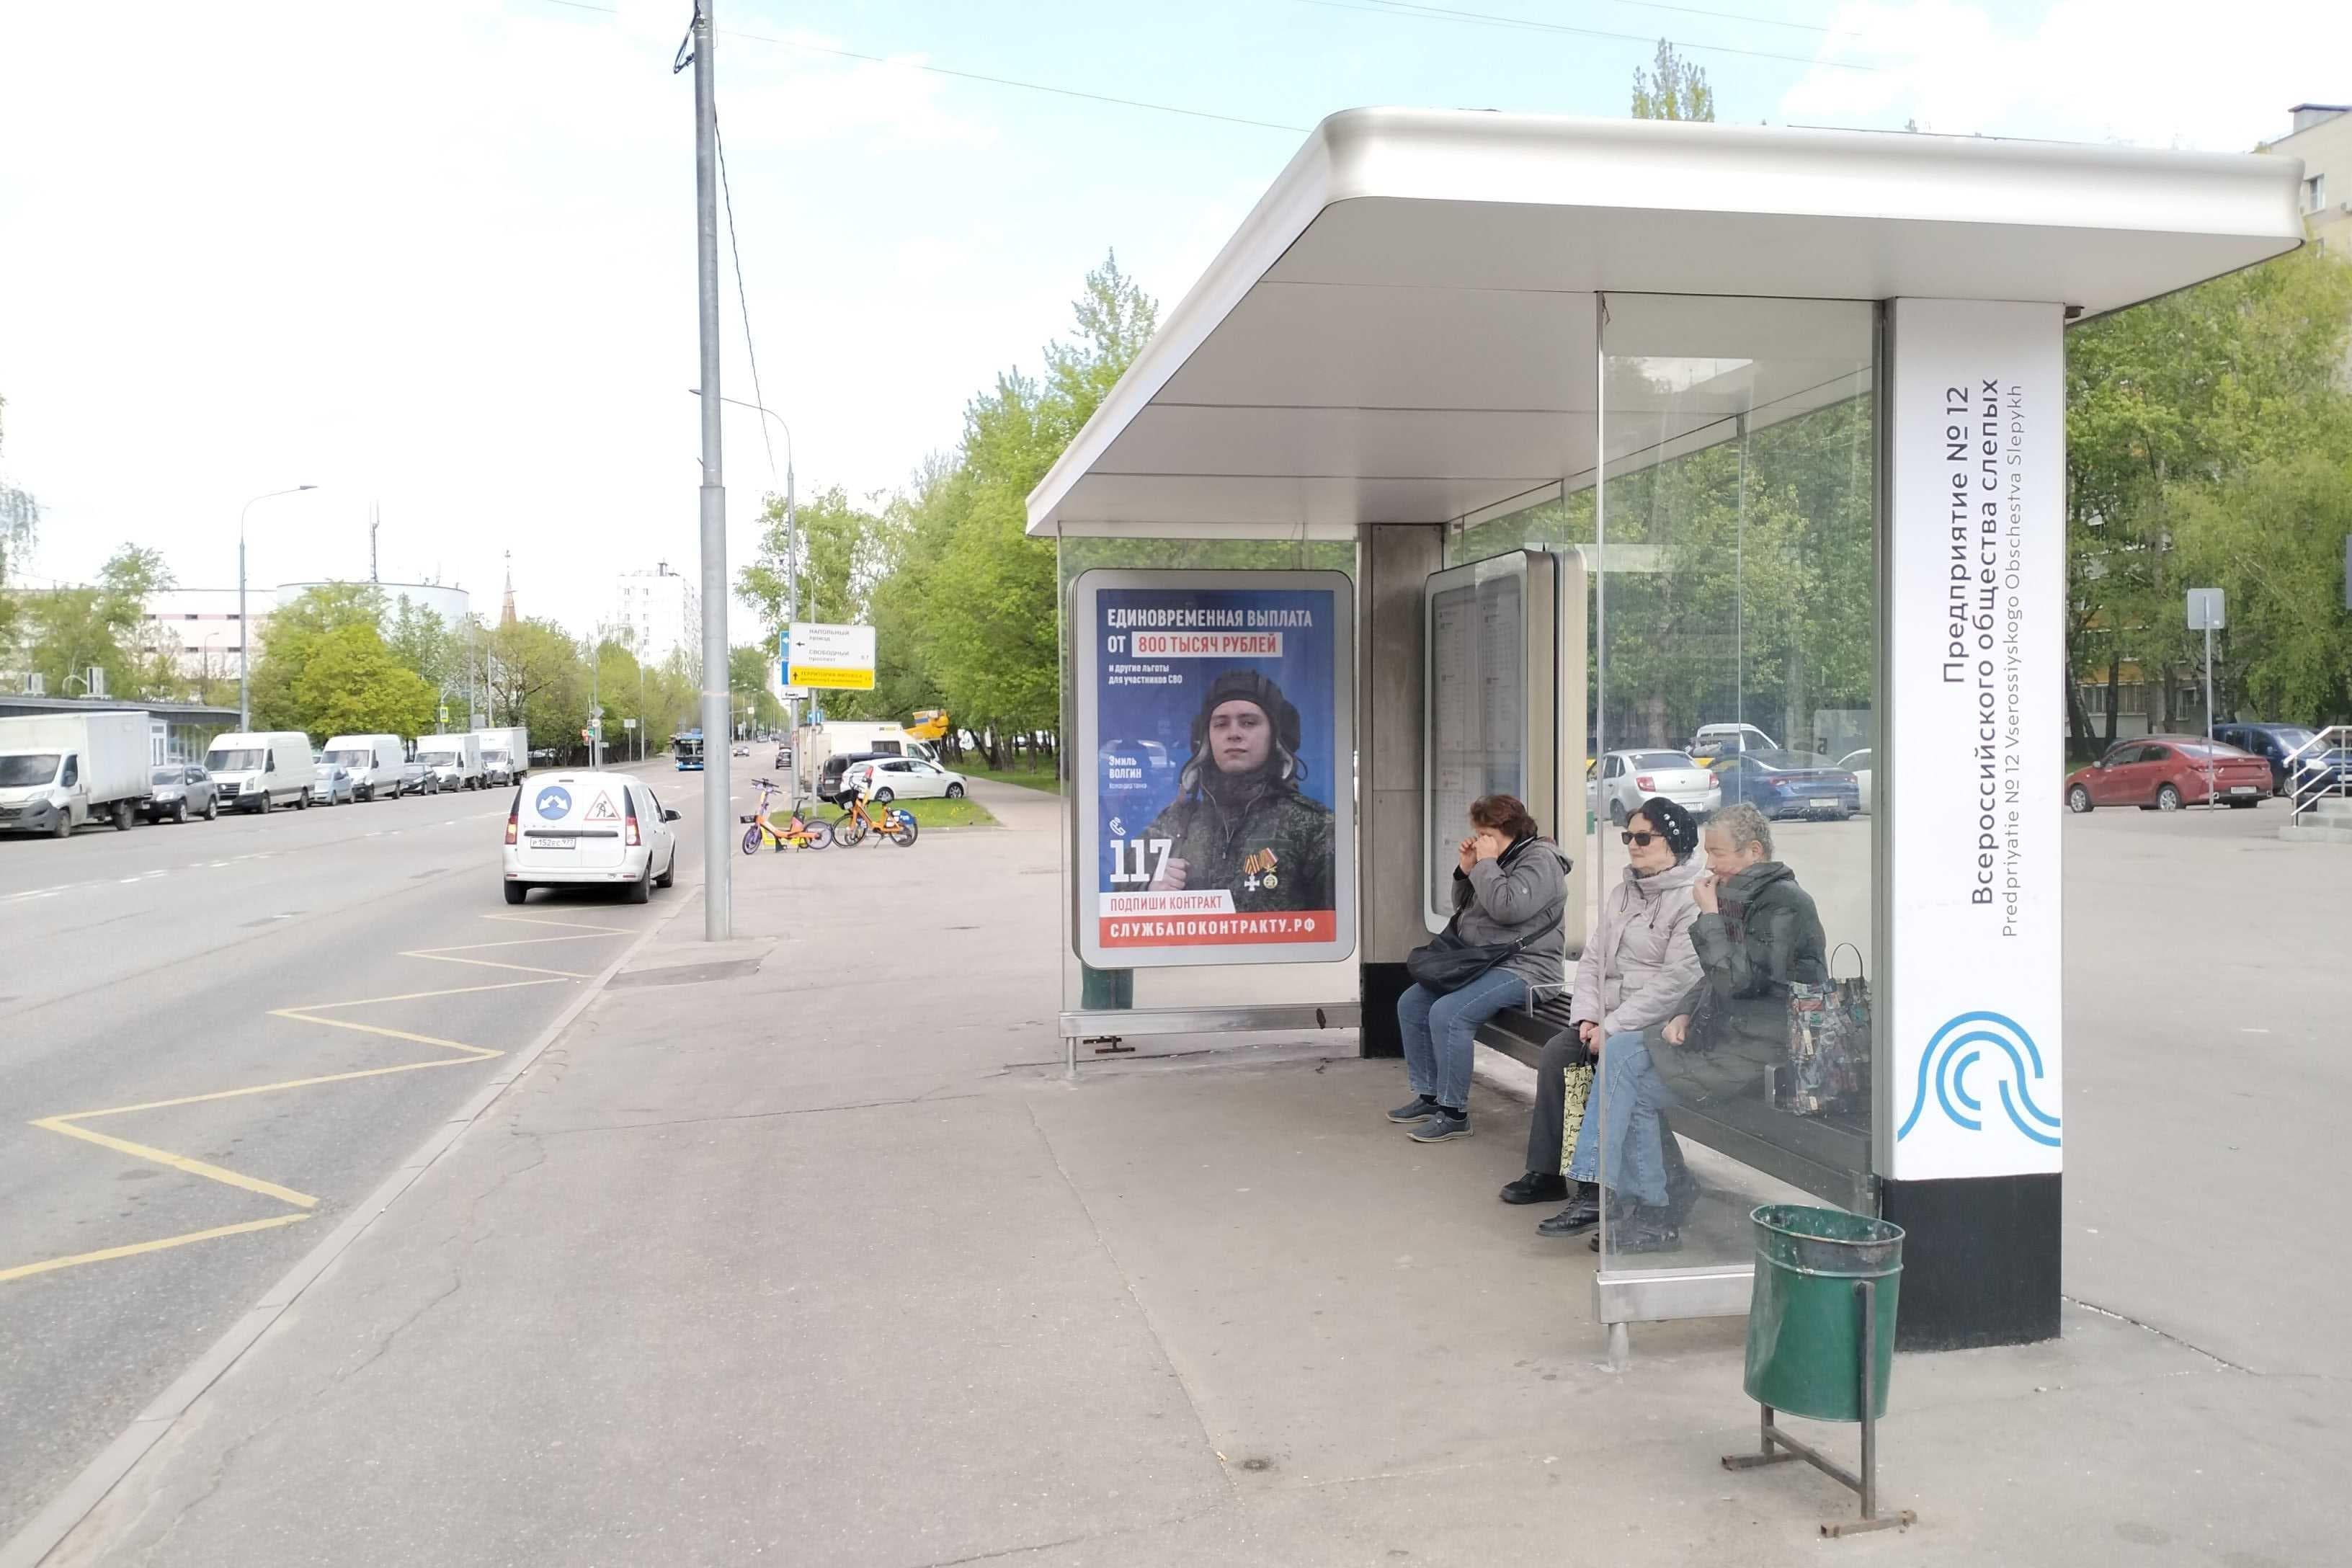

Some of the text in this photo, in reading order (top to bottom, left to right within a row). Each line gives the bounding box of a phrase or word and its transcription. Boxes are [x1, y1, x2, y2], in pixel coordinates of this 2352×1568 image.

[2006, 386, 2025, 466] Slepykh
[1943, 387, 1972, 682] Предприятие № 12
[2005, 473, 2021, 589] Obschestva
[1107, 608, 1313, 628] ЕДИНОВРЕМЕННАЯ ВЫПЛАТА
[1107, 633, 1277, 653] ОТ 800 ТЫСЯЧ РУБЛЕЙ
[1972, 379, 2000, 904] Всероссийского общества слепых
[1115, 664, 1141, 674] другие
[1142, 664, 1170, 673] льготы
[2003, 596, 2023, 749] Vserossiyskogo
[1108, 674, 1182, 685] для участников СВО
[1108, 755, 1137, 766] Эмиль
[2004, 754, 2020, 773] 12
[1109, 768, 1142, 779] ВОЛГИН
[1110, 839, 1172, 883] 117
[2001, 811, 2021, 937] Predpriyatie
[1110, 895, 1223, 912] ПОДПИШИ КОНТРАКТ
[1110, 917, 1315, 937] СЛУЖБАПОКОНТРАКТУ.РФ
